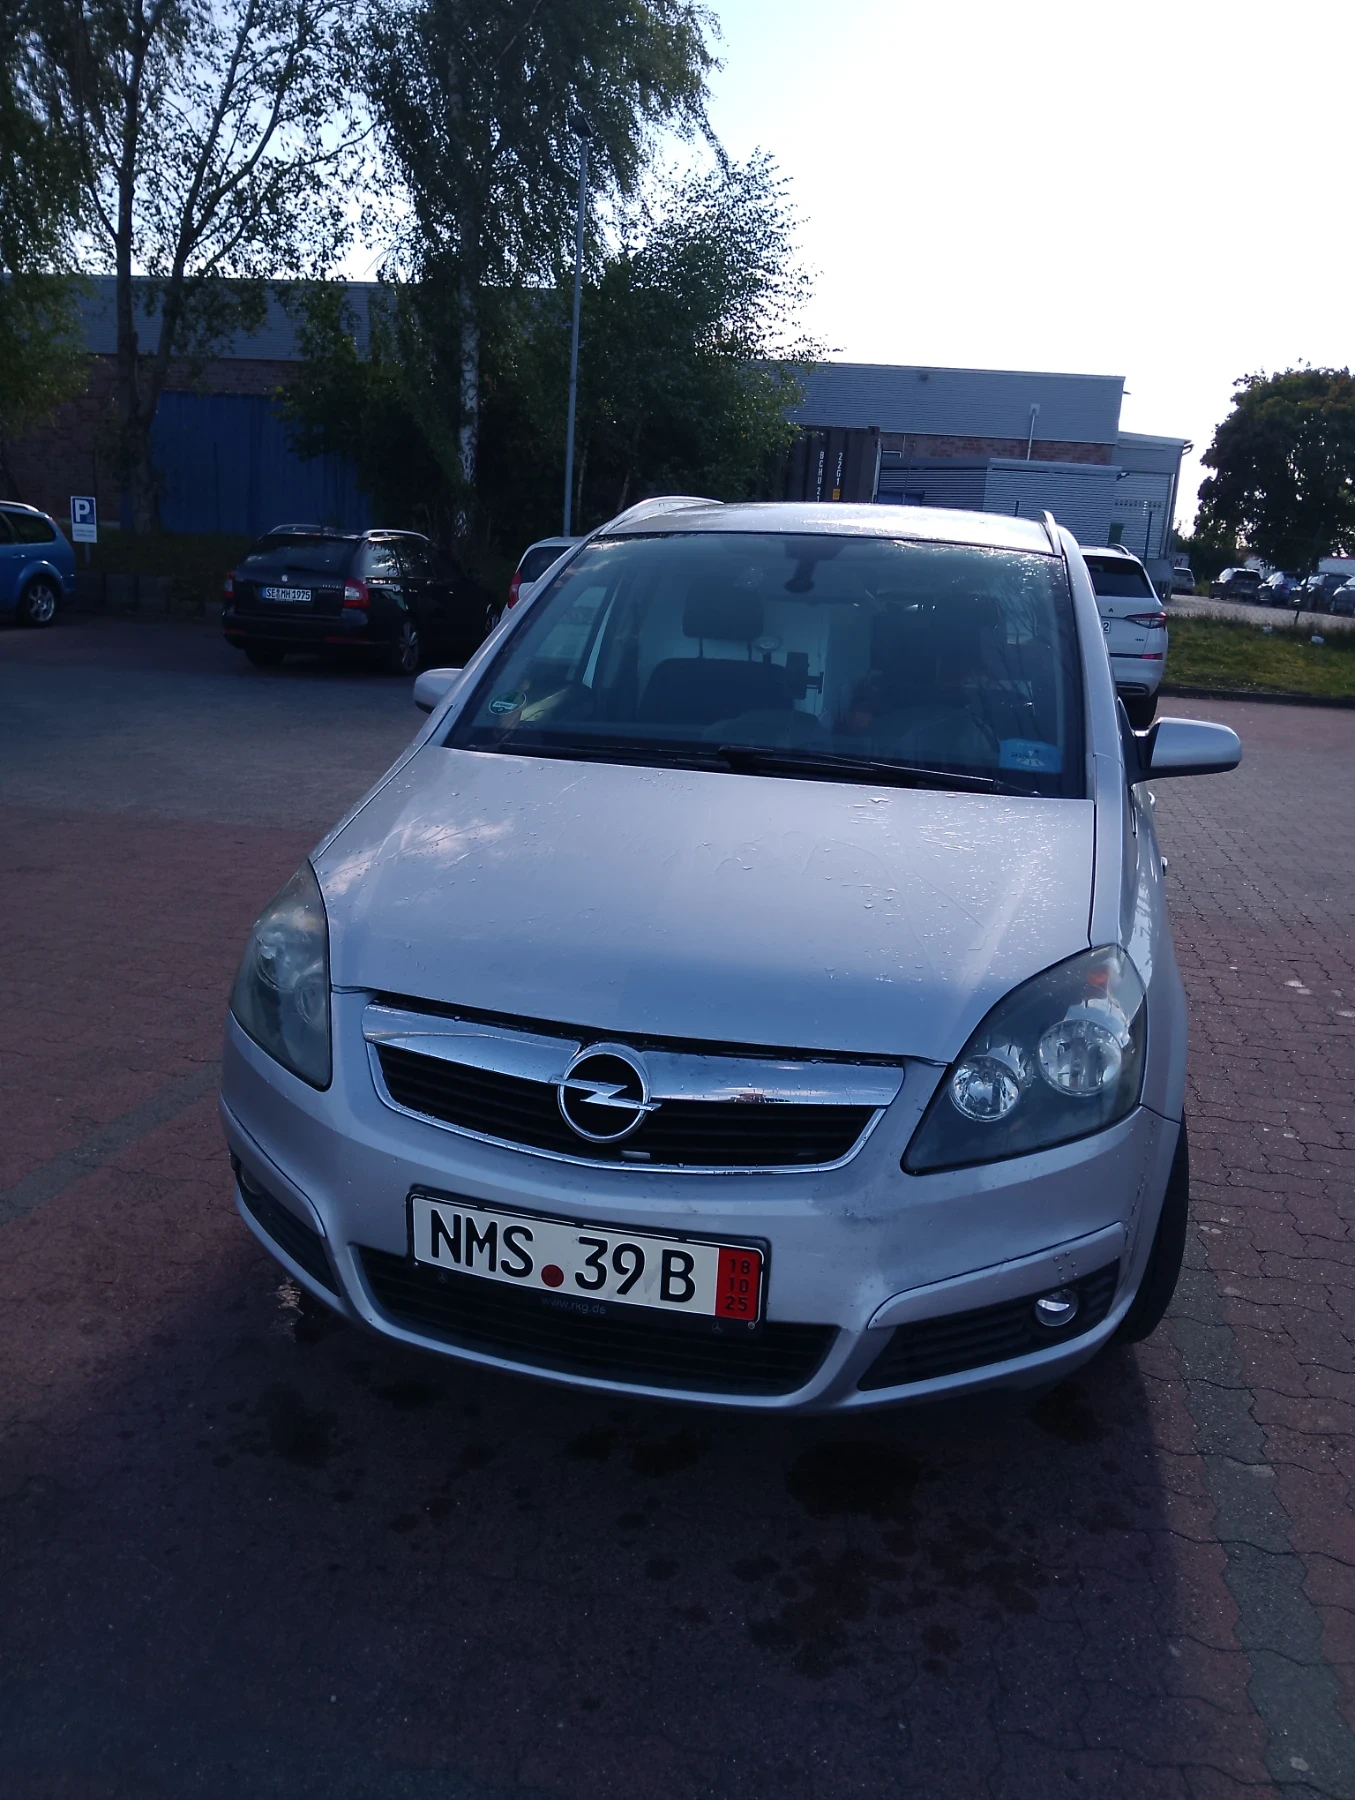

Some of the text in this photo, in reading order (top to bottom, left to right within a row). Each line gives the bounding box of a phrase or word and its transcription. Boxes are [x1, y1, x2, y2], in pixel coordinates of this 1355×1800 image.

[75, 500, 90, 522] P
[292, 590, 311, 600] 1975
[431, 1209, 696, 1303] NMS 39 B
[730, 1258, 750, 1274] 18
[729, 1277, 749, 1293] 10
[541, 1296, 607, 1315] www.rkg.de
[725, 1295, 747, 1311] 25
